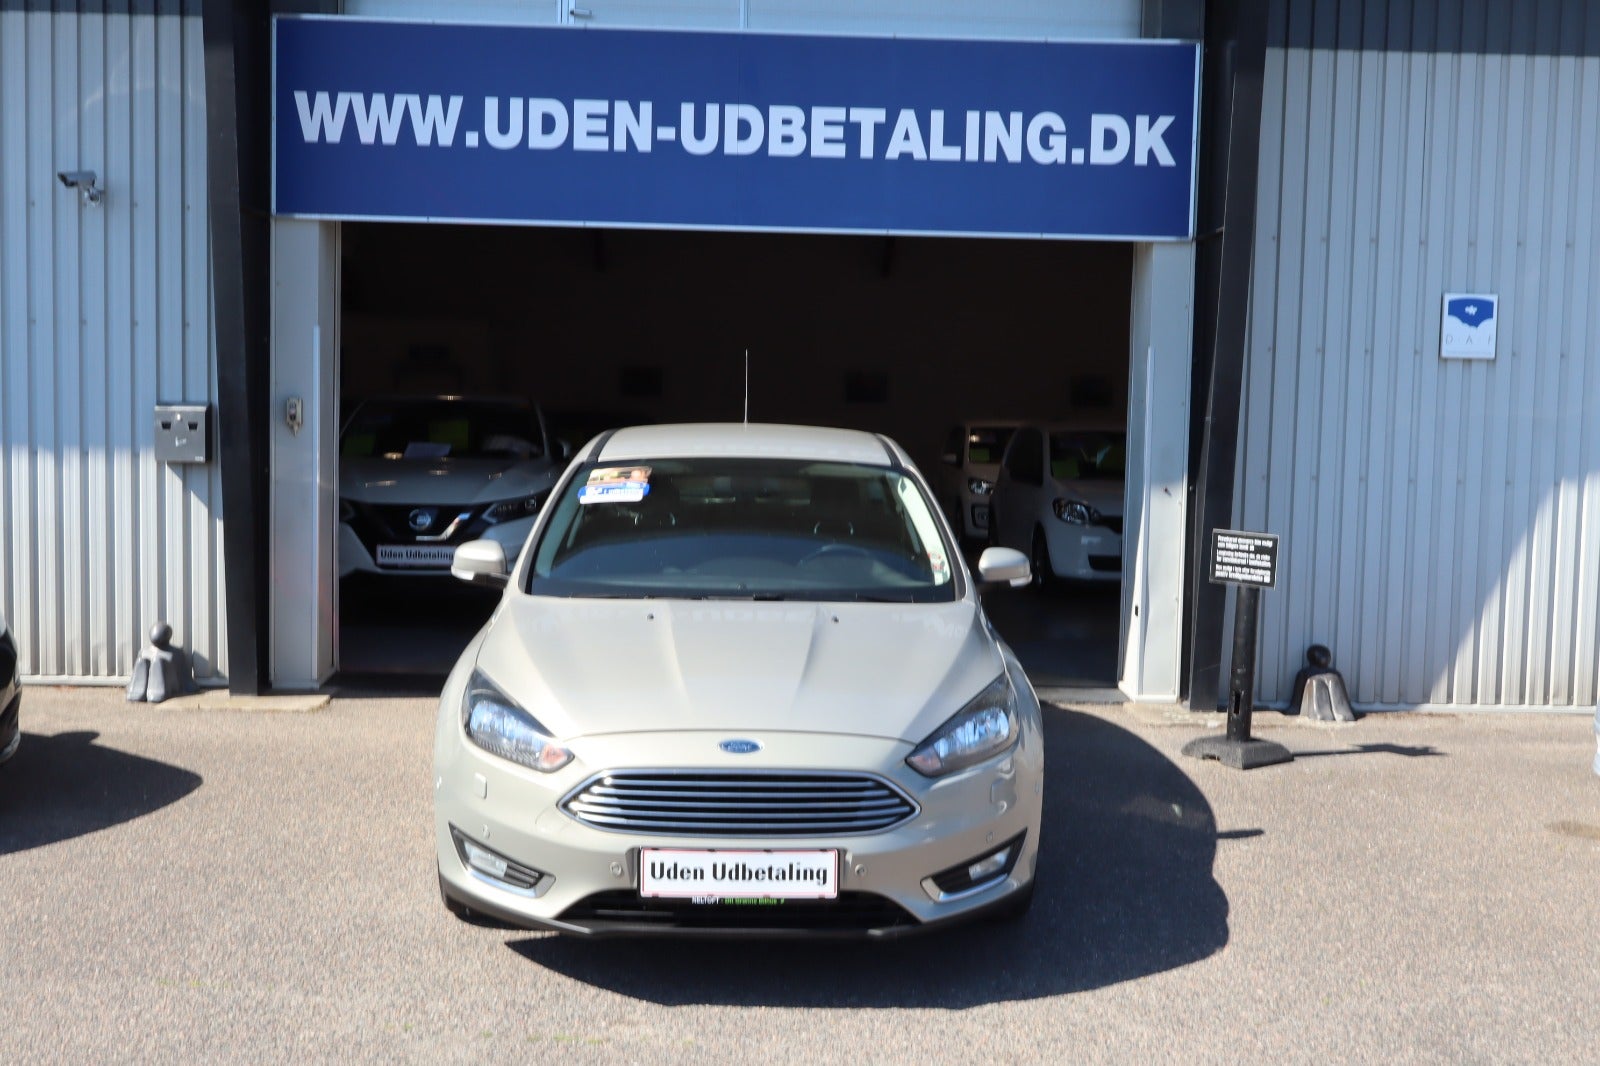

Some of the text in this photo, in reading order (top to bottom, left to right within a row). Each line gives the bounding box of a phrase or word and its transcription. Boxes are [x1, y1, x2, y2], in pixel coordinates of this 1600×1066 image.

[294, 91, 1176, 167] WWW.UDEN-UDBETALING.DK
[380, 549, 403, 560] Uden
[650, 862, 828, 886] Uden Udbetaling
